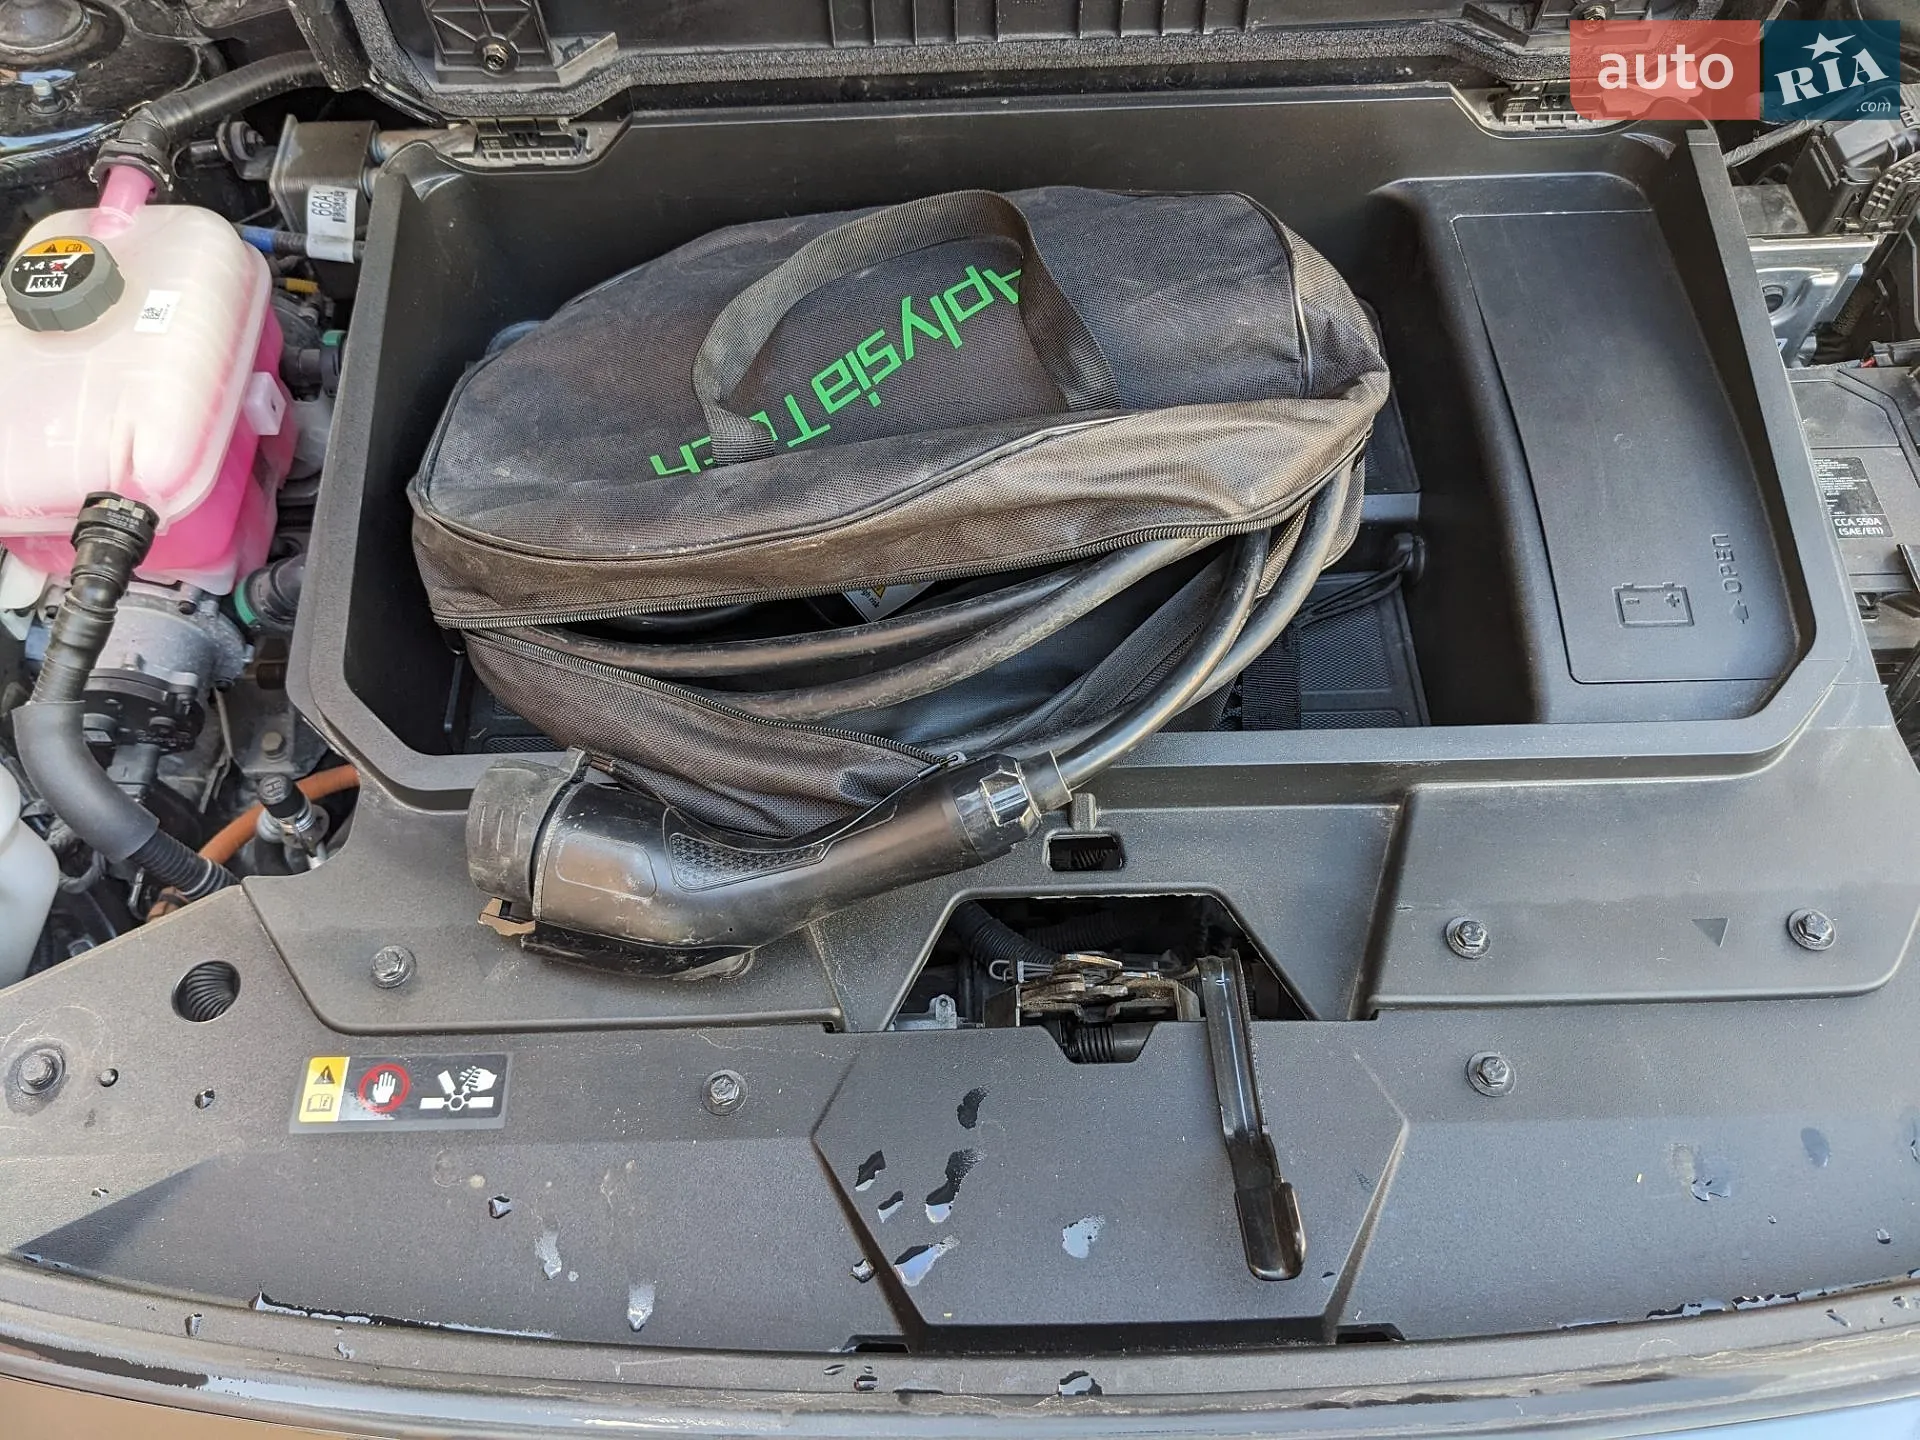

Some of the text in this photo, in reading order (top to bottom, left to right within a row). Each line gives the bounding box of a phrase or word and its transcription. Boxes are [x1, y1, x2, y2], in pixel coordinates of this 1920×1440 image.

[650, 265, 1022, 475] AplysiaTh
[1834, 517, 1882, 526] CCA 550A
[1709, 532, 1743, 594] OPEN
